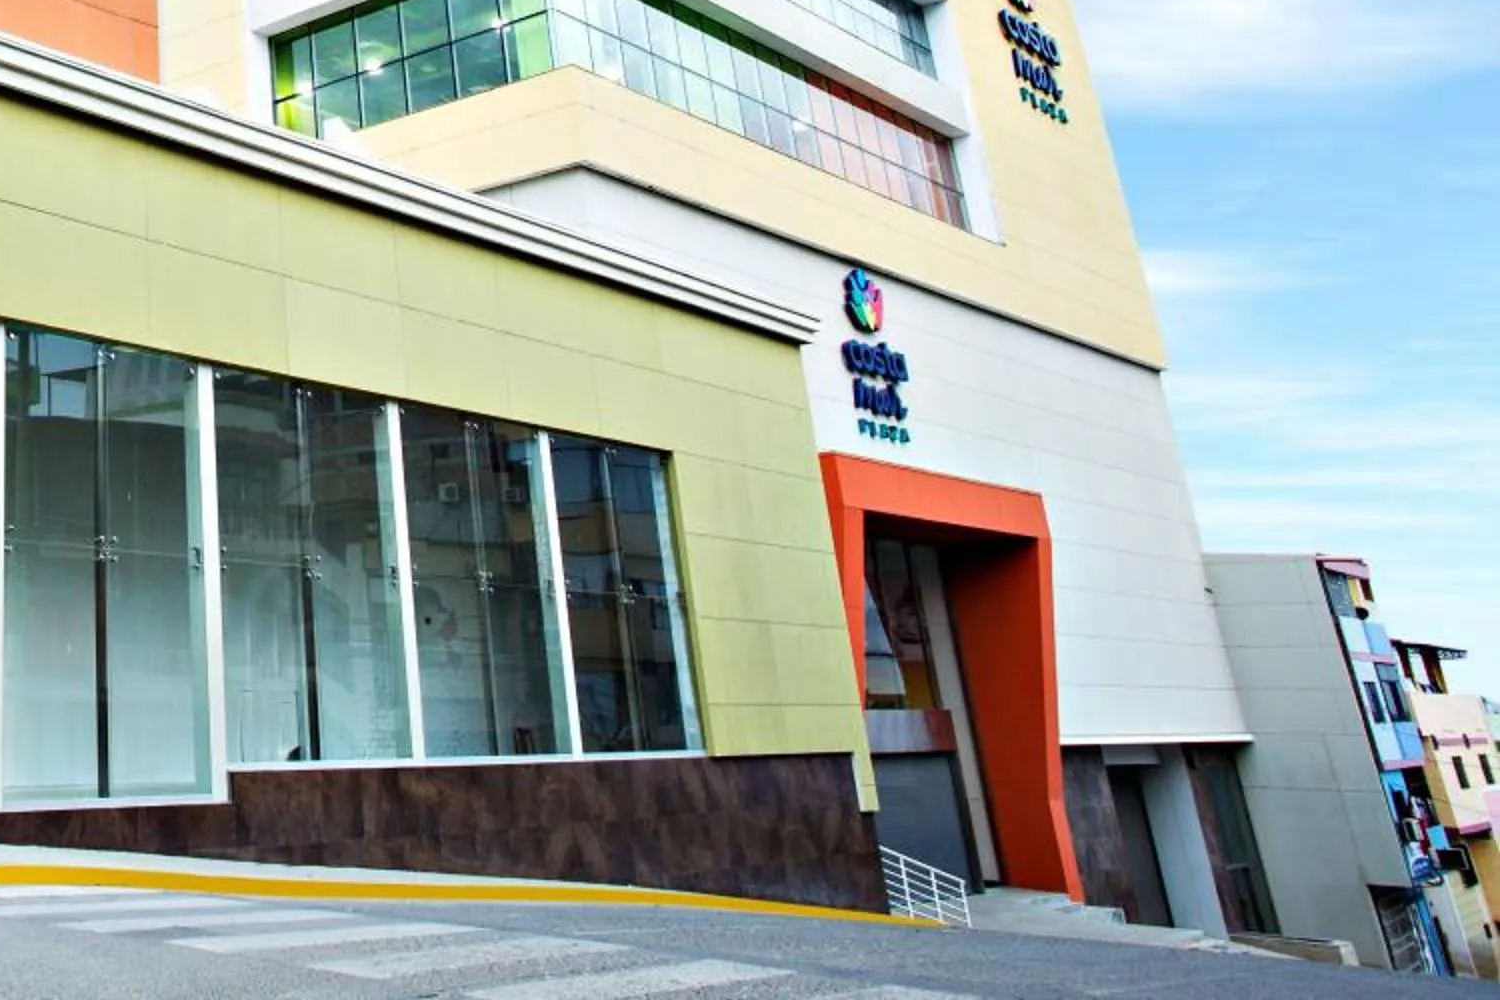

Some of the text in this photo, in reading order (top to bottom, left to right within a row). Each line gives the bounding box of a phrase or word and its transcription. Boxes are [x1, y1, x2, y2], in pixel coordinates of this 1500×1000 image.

[841, 338, 909, 382] costa
[852, 377, 909, 422] mar
[857, 418, 911, 443] PLAZA
